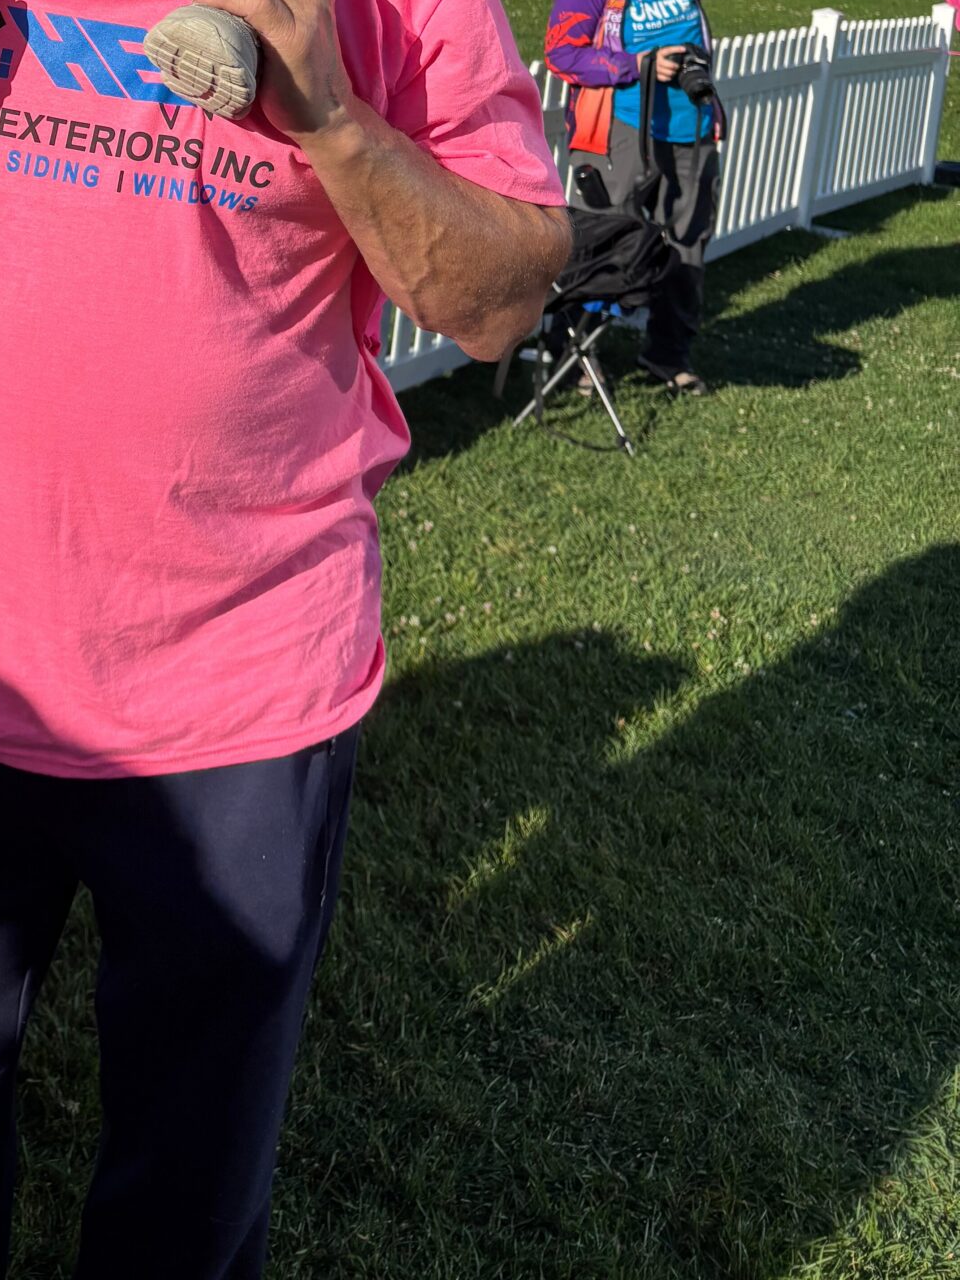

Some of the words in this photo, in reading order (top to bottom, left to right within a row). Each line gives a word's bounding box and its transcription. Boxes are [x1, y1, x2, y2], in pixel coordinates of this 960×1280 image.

[6, 148, 101, 189] SIDING
[132, 173, 260, 213] WINDOWS
[209, 146, 276, 189] INC
